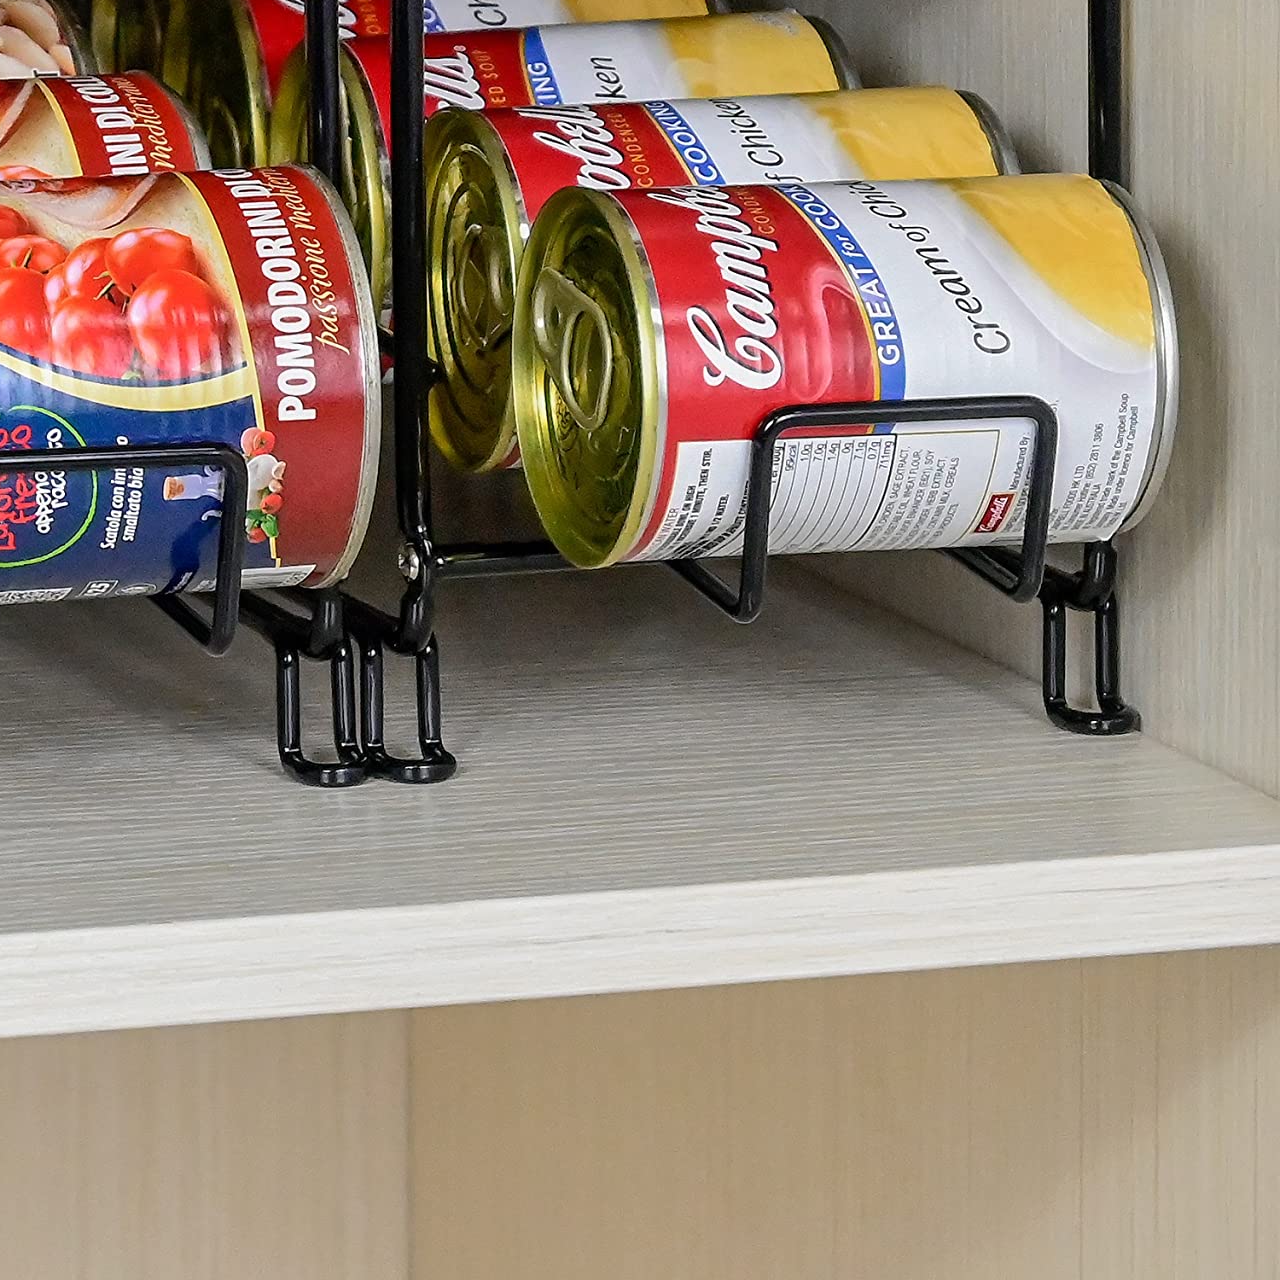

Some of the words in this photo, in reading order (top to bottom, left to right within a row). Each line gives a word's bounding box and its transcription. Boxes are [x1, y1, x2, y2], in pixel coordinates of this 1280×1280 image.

[888, 221, 932, 243] of
[835, 234, 864, 258] for
[299, 236, 351, 355] passione
[915, 246, 1011, 355] Cream
[237, 195, 318, 423] POMODORINI
[854, 266, 901, 366] GREAT
[1119, 393, 1130, 413] Soup
[1093, 423, 1103, 442] 3806
[1114, 414, 1129, 449] Campbell
[1126, 406, 1141, 441] Campbell
[814, 443, 826, 462] 7.0g
[828, 443, 839, 461] 1.4g
[843, 442, 853, 454] 0g
[868, 441, 881, 460] 0.7g
[879, 441, 894, 469] 711mg
[924, 450, 935, 464] SOY
[1090, 444, 1101, 461] 2811
[1112, 450, 1121, 461] the
[1125, 442, 1133, 451] for
[945, 457, 959, 488] CEREALS
[1009, 447, 1027, 490] Manufactured
[1020, 436, 1031, 446] By
[699, 468, 710, 487] THEN
[889, 481, 902, 498] SAGE
[34, 471, 55, 534] appena
[99, 509, 123, 550] Scatola
[111, 486, 126, 509] con
[122, 489, 142, 543] smaltato
